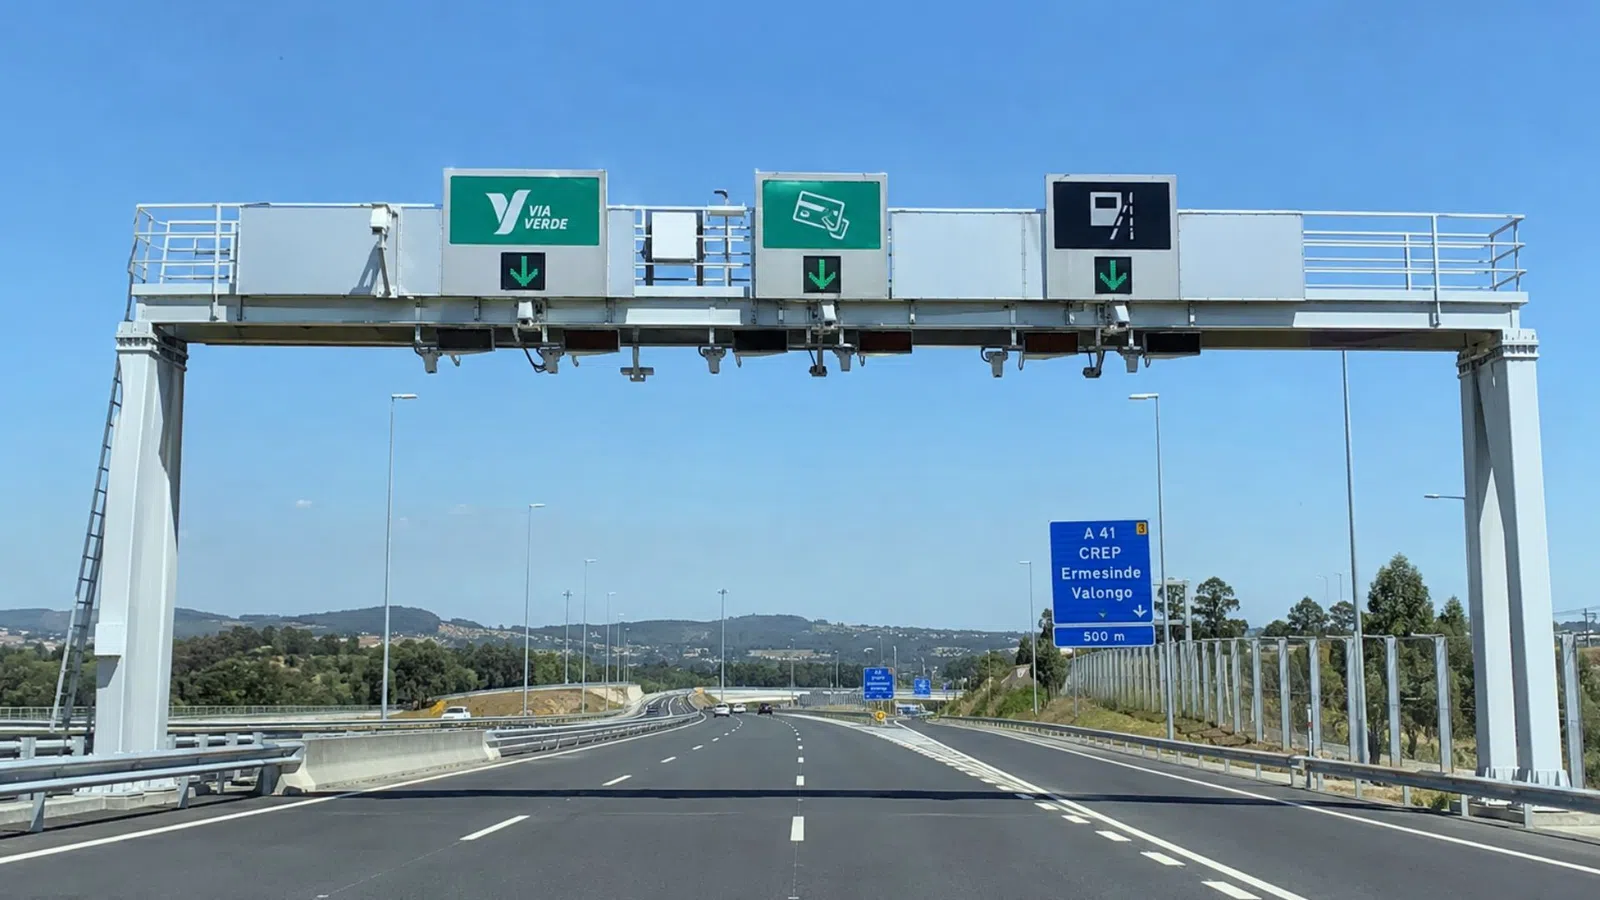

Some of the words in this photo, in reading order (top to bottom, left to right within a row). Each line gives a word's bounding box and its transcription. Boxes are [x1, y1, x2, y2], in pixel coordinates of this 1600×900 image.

[529, 205, 551, 217] VIA
[524, 218, 568, 230] VERDE
[1084, 527, 1094, 540] A
[1099, 526, 1116, 539] 41
[1138, 523, 1146, 534] 3
[1079, 546, 1121, 560] CREP
[1061, 566, 1141, 580] Ermesinde
[1071, 586, 1133, 602] Valongo
[1083, 631, 1108, 642] 500
[1114, 633, 1125, 642] m
